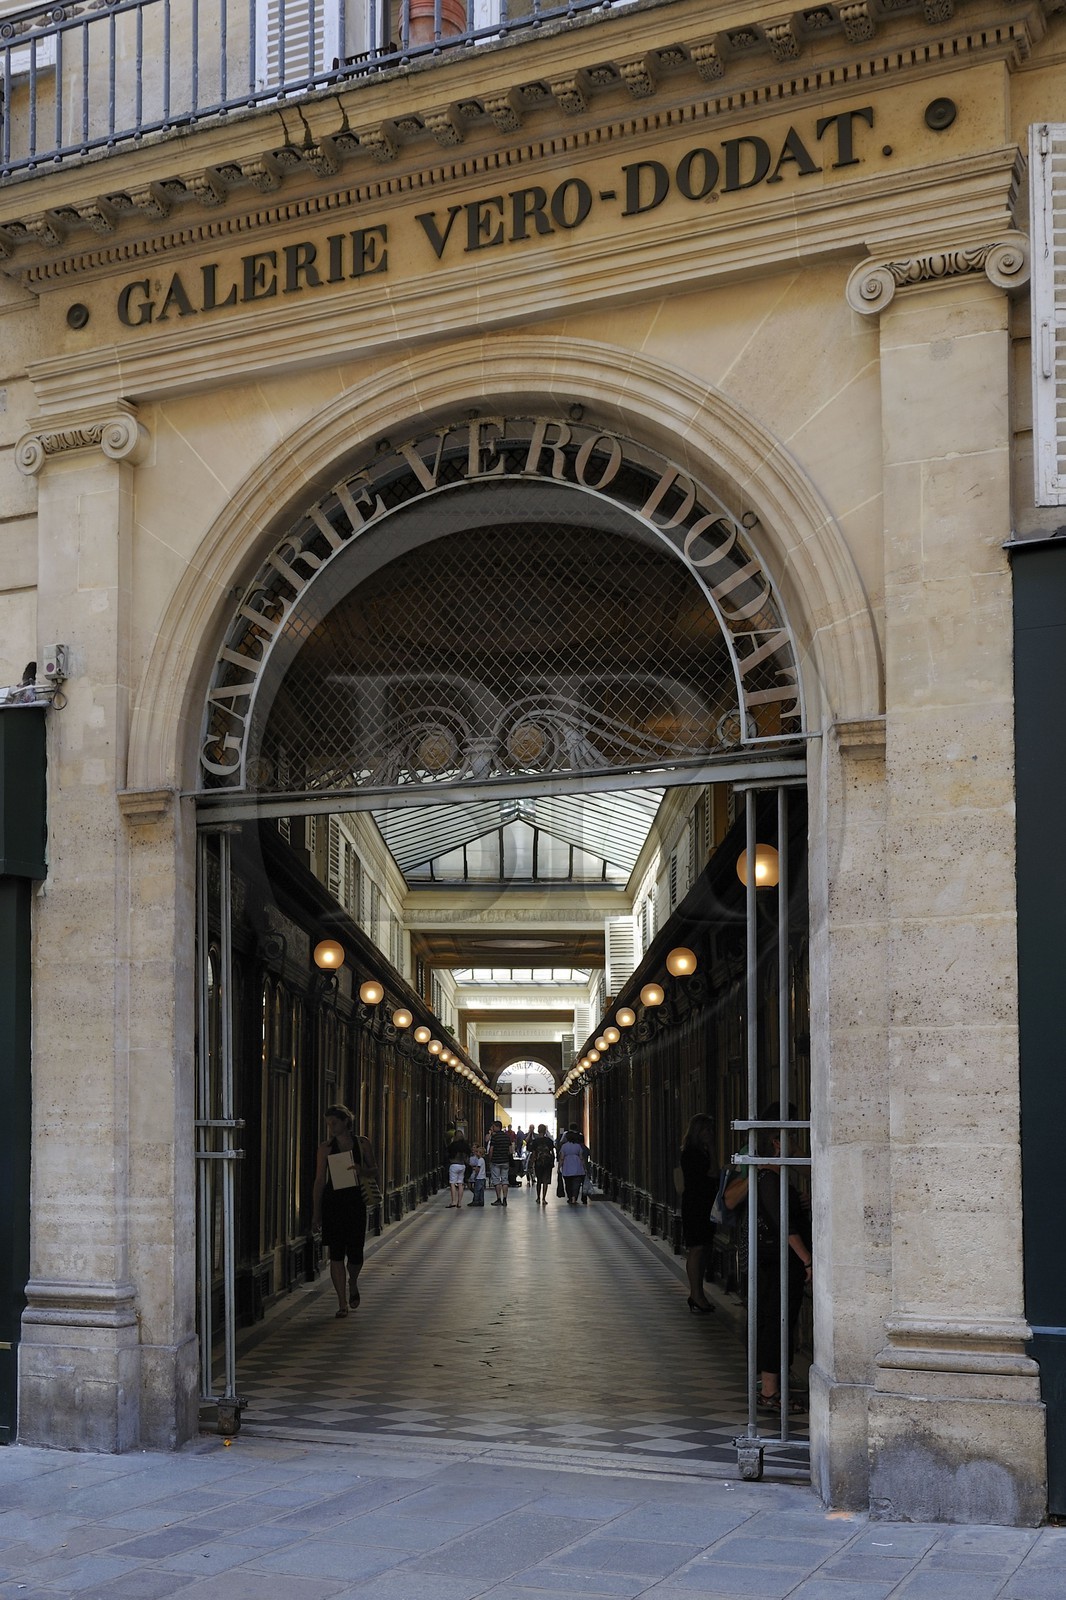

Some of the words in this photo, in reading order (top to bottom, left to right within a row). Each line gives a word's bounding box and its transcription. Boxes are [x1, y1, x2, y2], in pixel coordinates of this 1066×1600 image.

[117, 223, 389, 327] GALERIE
[200, 470, 386, 777] GALERIE
[396, 417, 623, 492] VERO
[636, 460, 802, 720] DODAT
